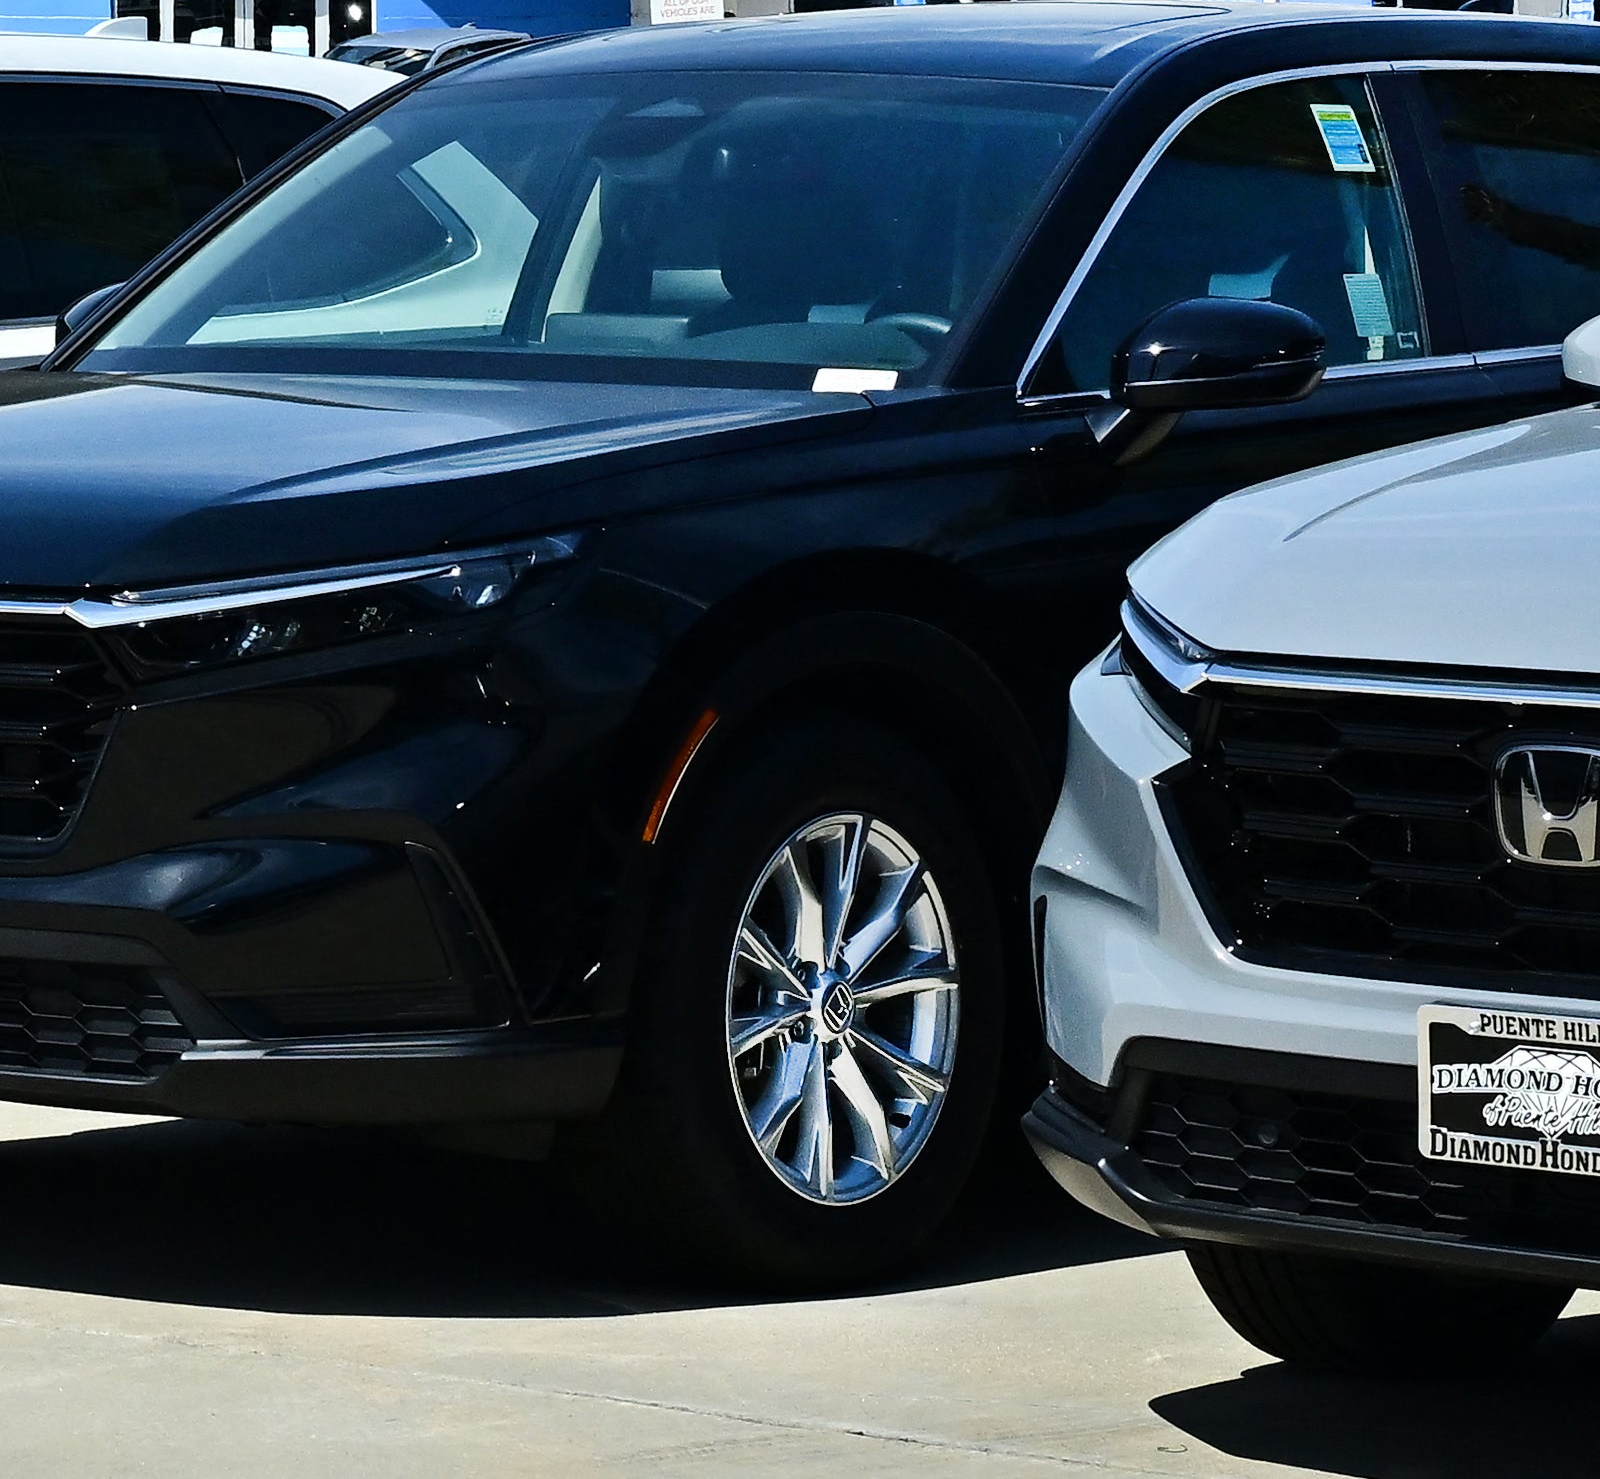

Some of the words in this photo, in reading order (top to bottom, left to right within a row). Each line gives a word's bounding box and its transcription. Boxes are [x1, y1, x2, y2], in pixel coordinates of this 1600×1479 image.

[660, 7, 697, 18] VEHICLES
[699, 6, 715, 14] ARE
[1479, 1013, 1557, 1040] PUENTE
[1437, 1068, 1563, 1093] DIAMOND
[1500, 1096, 1561, 1128] Puente
